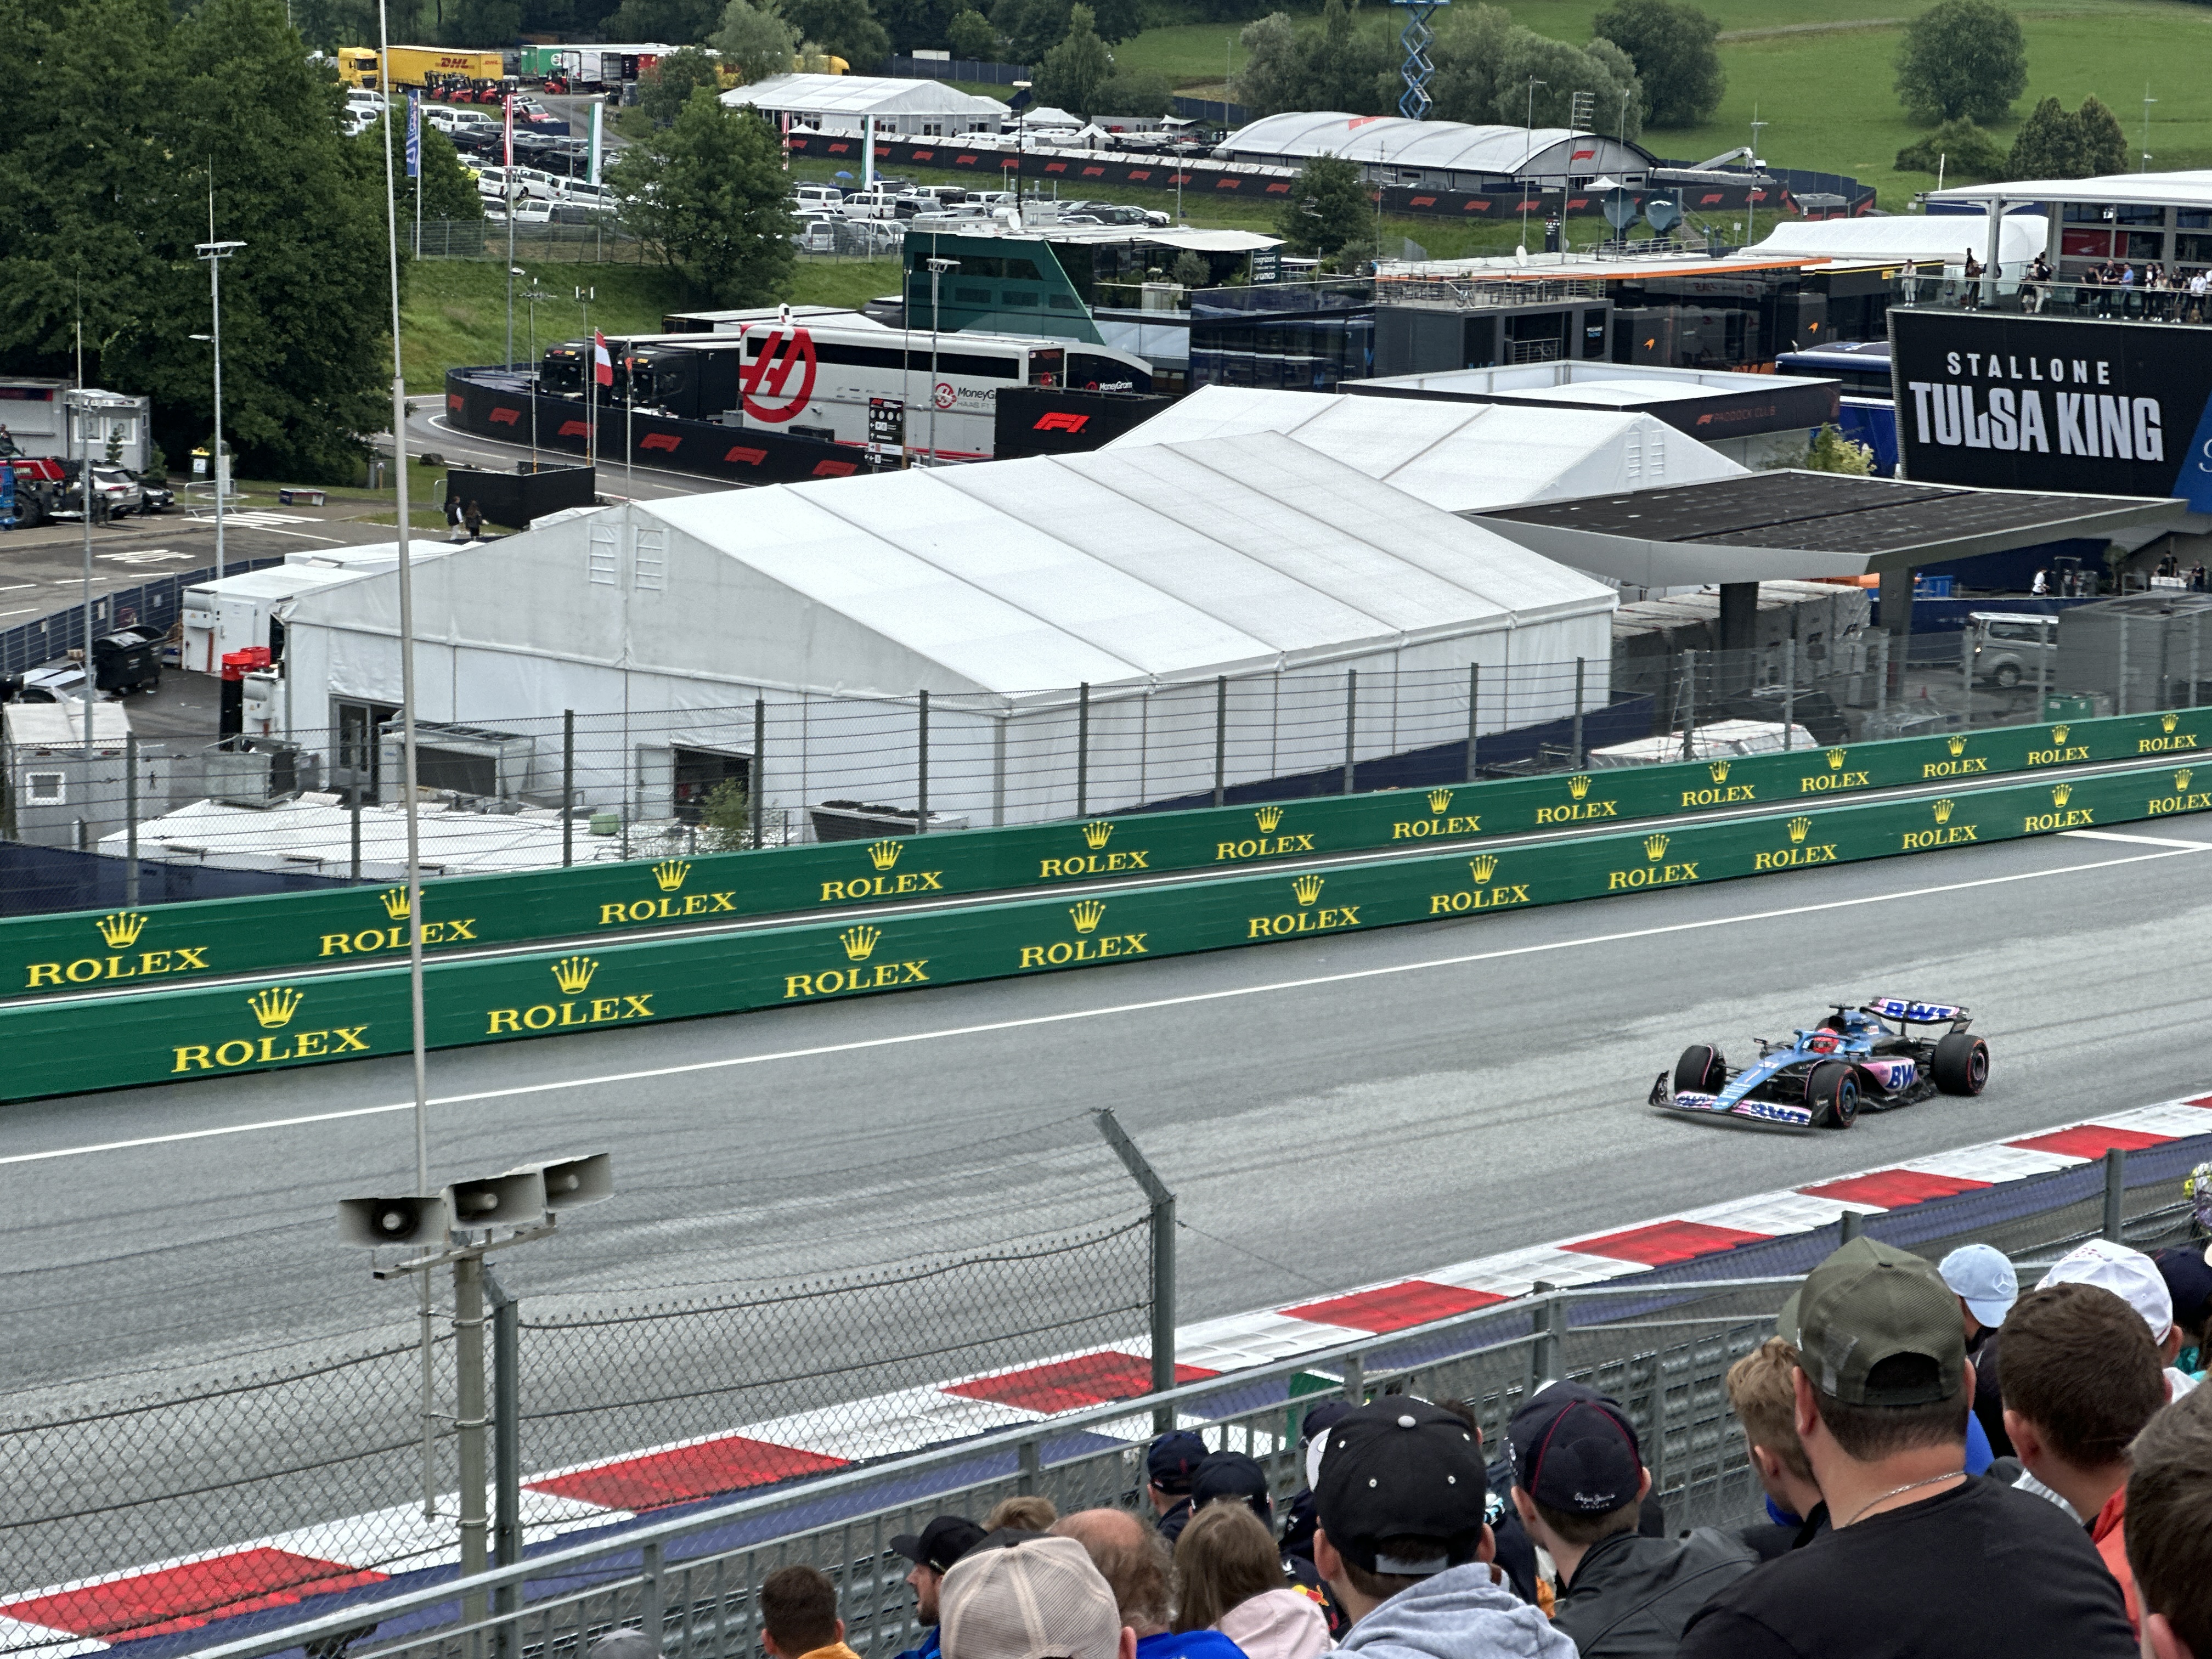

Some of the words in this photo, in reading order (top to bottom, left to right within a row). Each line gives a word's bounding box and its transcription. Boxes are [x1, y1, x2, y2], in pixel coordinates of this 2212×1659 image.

[441, 57, 470, 69] DHL
[1948, 352, 2109, 385] STALLONE
[1099, 381, 1133, 392] MoneyGram
[1713, 408, 1752, 422] PADDOCK
[1754, 405, 1776, 417] CLUB
[1909, 381, 2050, 454] TULSA
[2056, 392, 2164, 462] KING
[2028, 746, 2089, 765] ROLEX
[2138, 735, 2196, 752] ROLEX
[1922, 758, 1987, 777] ROLEX
[1801, 771, 1869, 792] ROLEX
[1681, 784, 1755, 807] ROLEX
[2148, 793, 2211, 814] ROLEX
[1537, 800, 1617, 824] ROLEX
[2024, 809, 2093, 832] ROLEX
[1393, 815, 1481, 839] ROLEX
[1903, 825, 1977, 850] ROLEX
[1217, 834, 1314, 860] ROLEX
[1754, 844, 1836, 870] ROLEX
[1041, 850, 1148, 878] ROLEX
[1609, 862, 1698, 890] ROLEX
[820, 871, 943, 901] ROLEX
[1430, 884, 1530, 914] ROLEX
[600, 891, 736, 924] ROLEX
[1249, 906, 1359, 938] ROLEX
[320, 918, 477, 956] ROLEX
[1020, 933, 1147, 968] ROLEX
[27, 946, 208, 988] ROLEX
[785, 960, 929, 998] ROLEX
[488, 994, 653, 1034] ROLEX
[1883, 1002, 1953, 1020] BWT
[173, 1025, 369, 1073] ROLEX
[1885, 1064, 1915, 1090] BW
